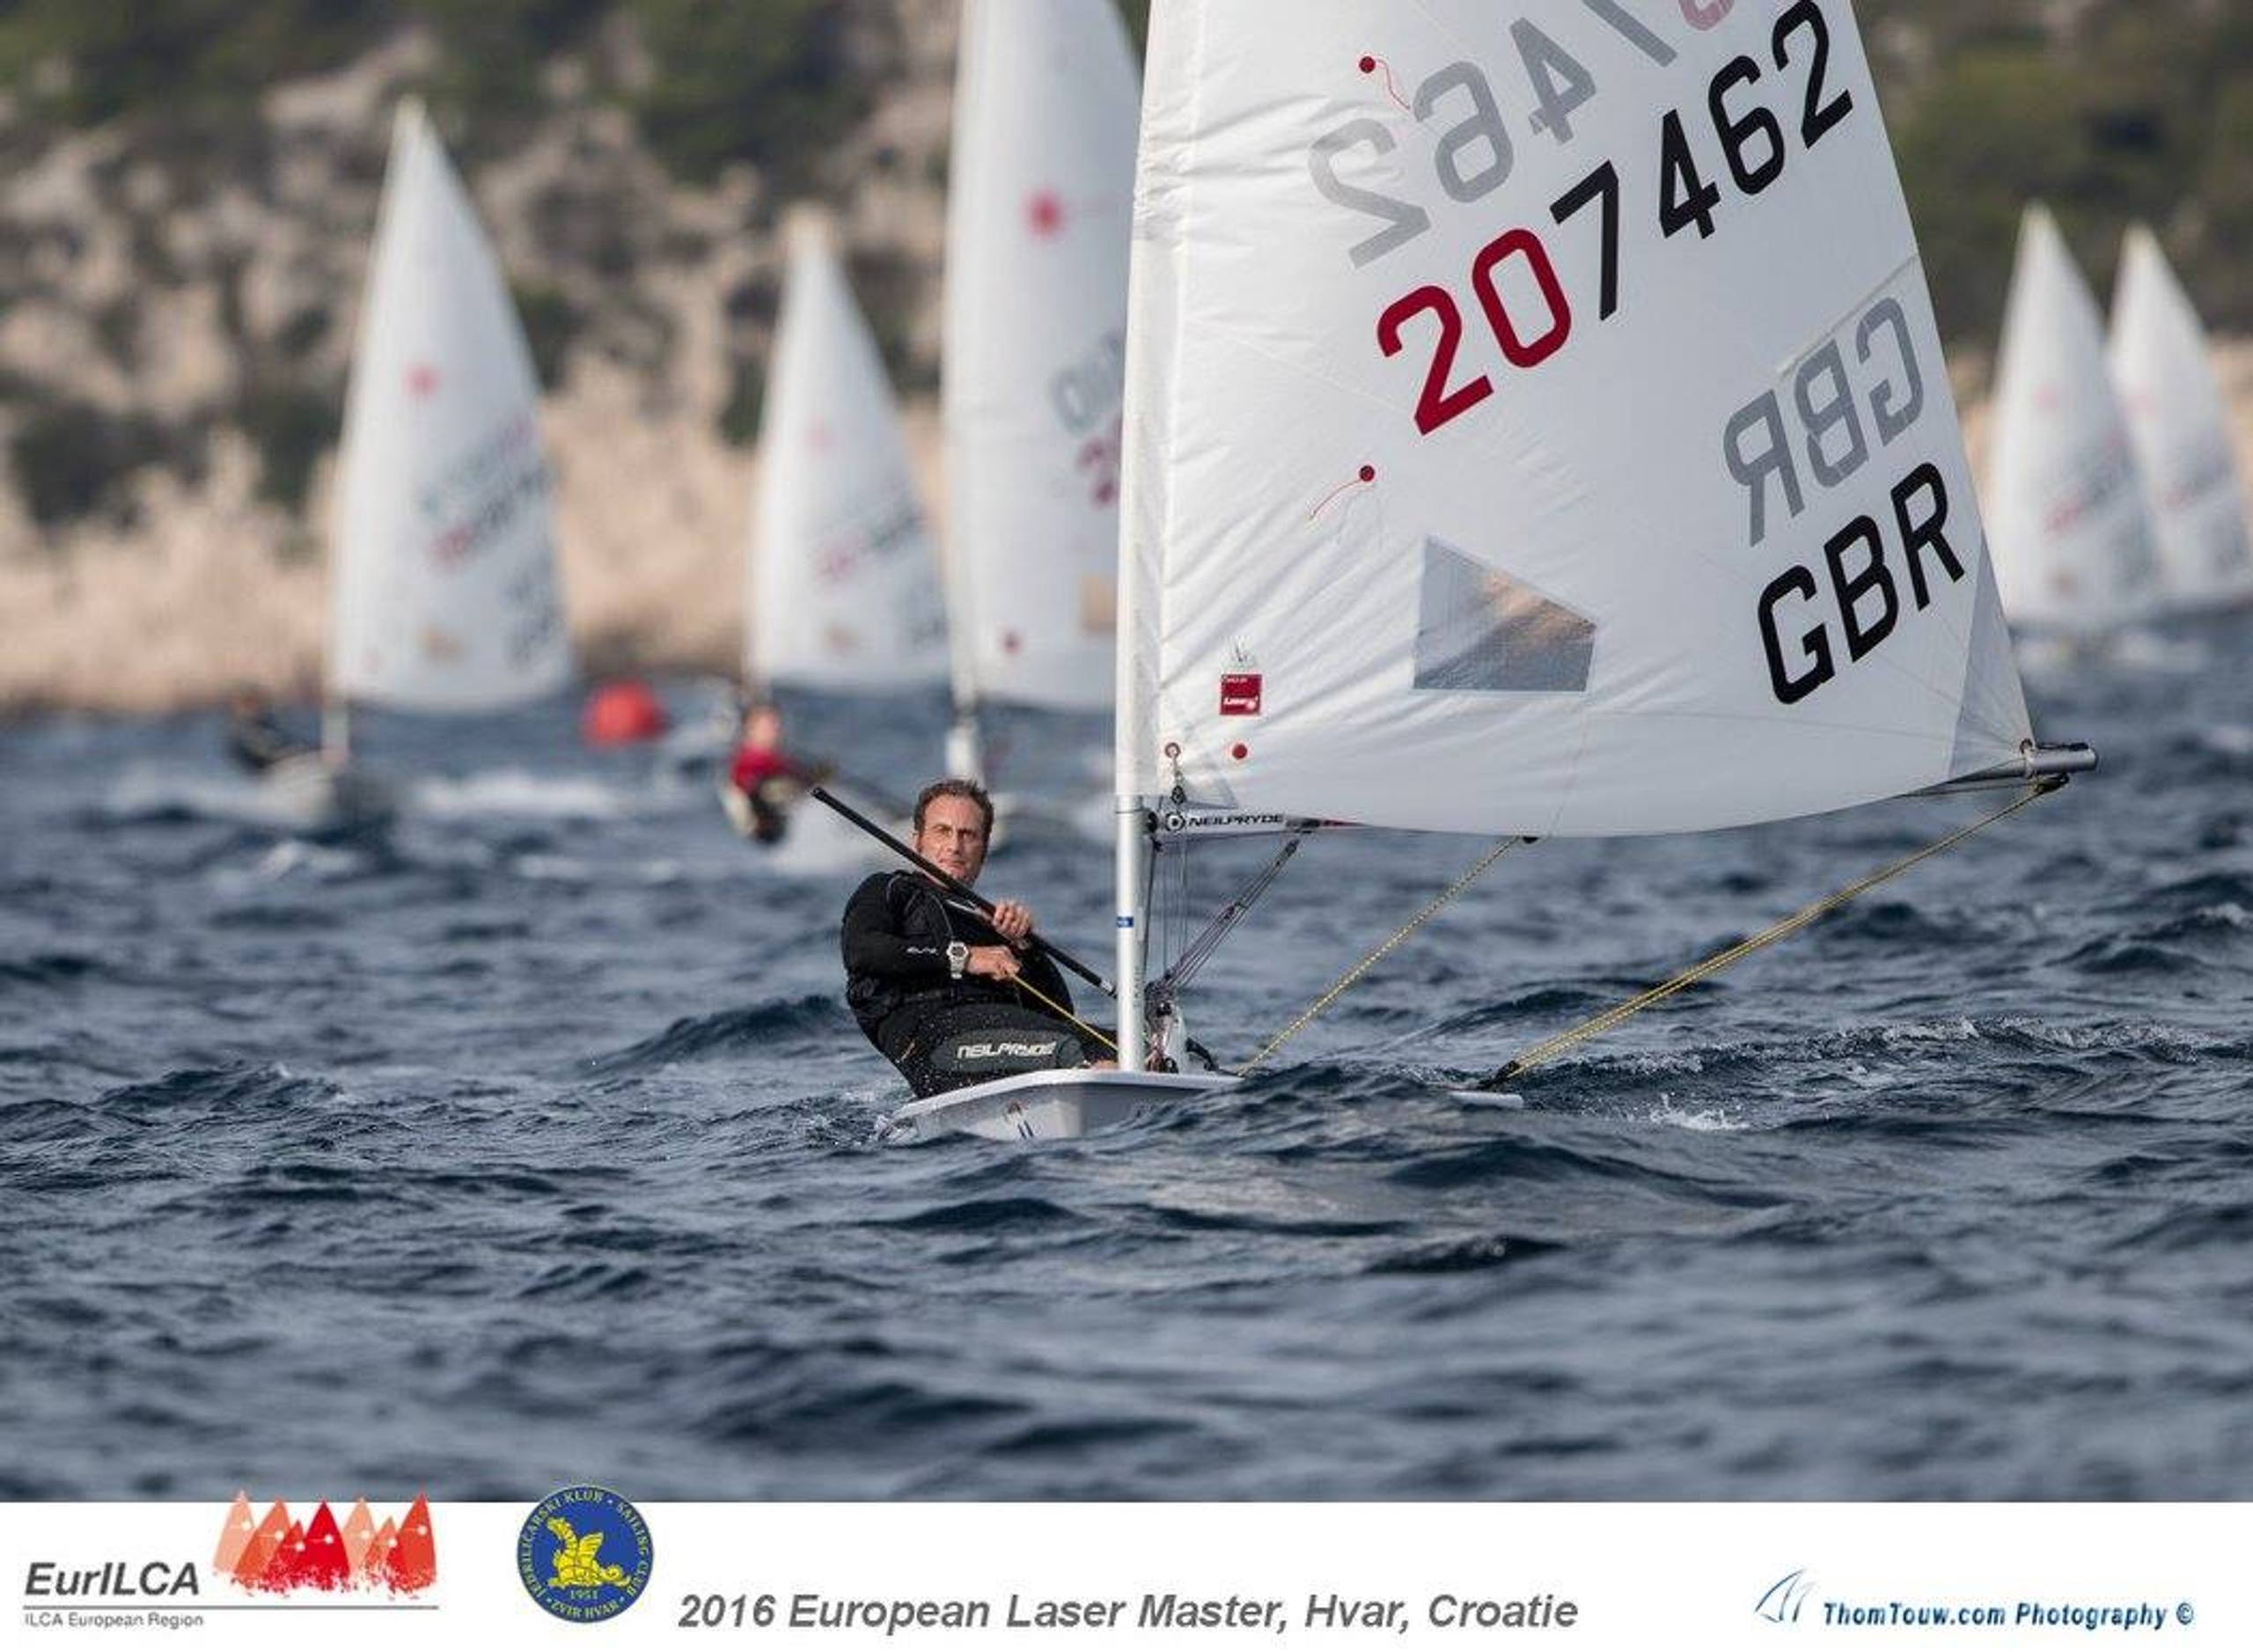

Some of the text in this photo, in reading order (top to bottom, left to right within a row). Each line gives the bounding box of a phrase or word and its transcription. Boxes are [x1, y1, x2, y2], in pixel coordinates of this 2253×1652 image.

[1376, 0, 1853, 435] 207462
[1758, 462, 1965, 704] GBR
[1189, 814, 1283, 827] NEILPRYDE
